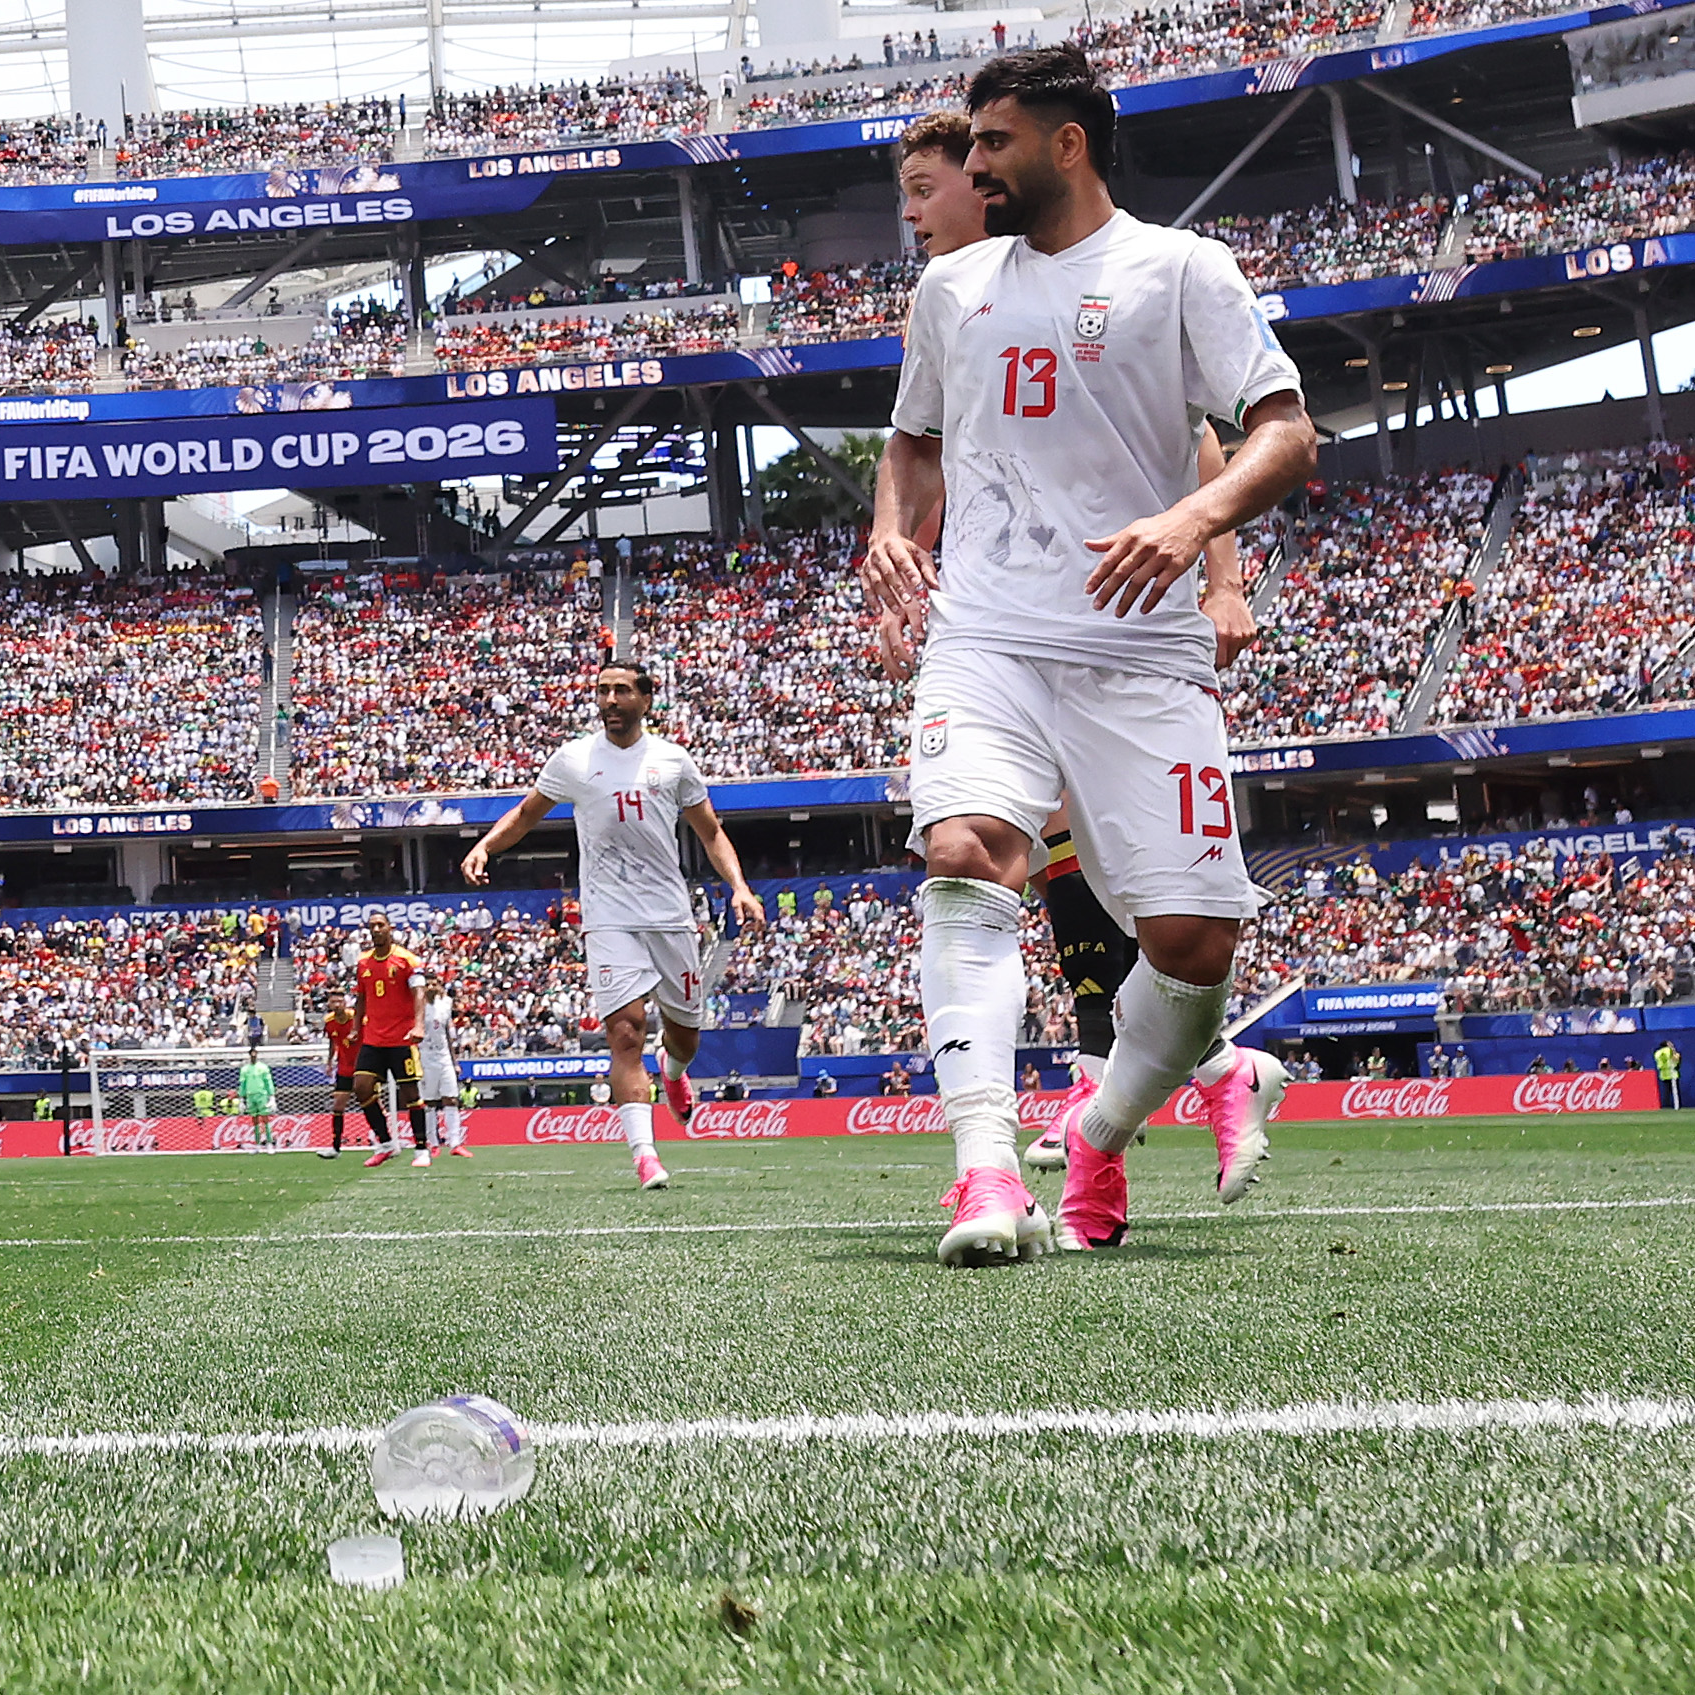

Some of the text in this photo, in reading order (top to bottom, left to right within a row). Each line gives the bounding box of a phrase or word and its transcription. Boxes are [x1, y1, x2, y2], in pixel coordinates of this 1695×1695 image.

[861, 119, 907, 141] FIFA
[468, 150, 622, 179] LOS ANGELES
[106, 198, 415, 239] LOS ANGELES
[1565, 243, 1635, 281] LOS
[447, 360, 664, 399] LOS ANGELES
[997, 346, 1058, 419] 13
[3, 421, 524, 480] FIFA WORLD CUP 2026
[1227, 749, 1316, 773] NGELES
[612, 790, 644, 823] 14
[1167, 762, 1233, 840] 13
[52, 815, 193, 835] LOS ANGELES
[375, 980, 385, 998] 8
[1317, 994, 1415, 1012] FIFA WORLD CUP
[473, 1062, 503, 1075] FIFA
[503, 1061, 553, 1074] WORLD
[554, 1060, 582, 1074] CUP
[1341, 1078, 1454, 1118] Coca-Cola
[1513, 1071, 1626, 1113] Coca-Cola
[685, 1100, 792, 1139] Coca-Cola
